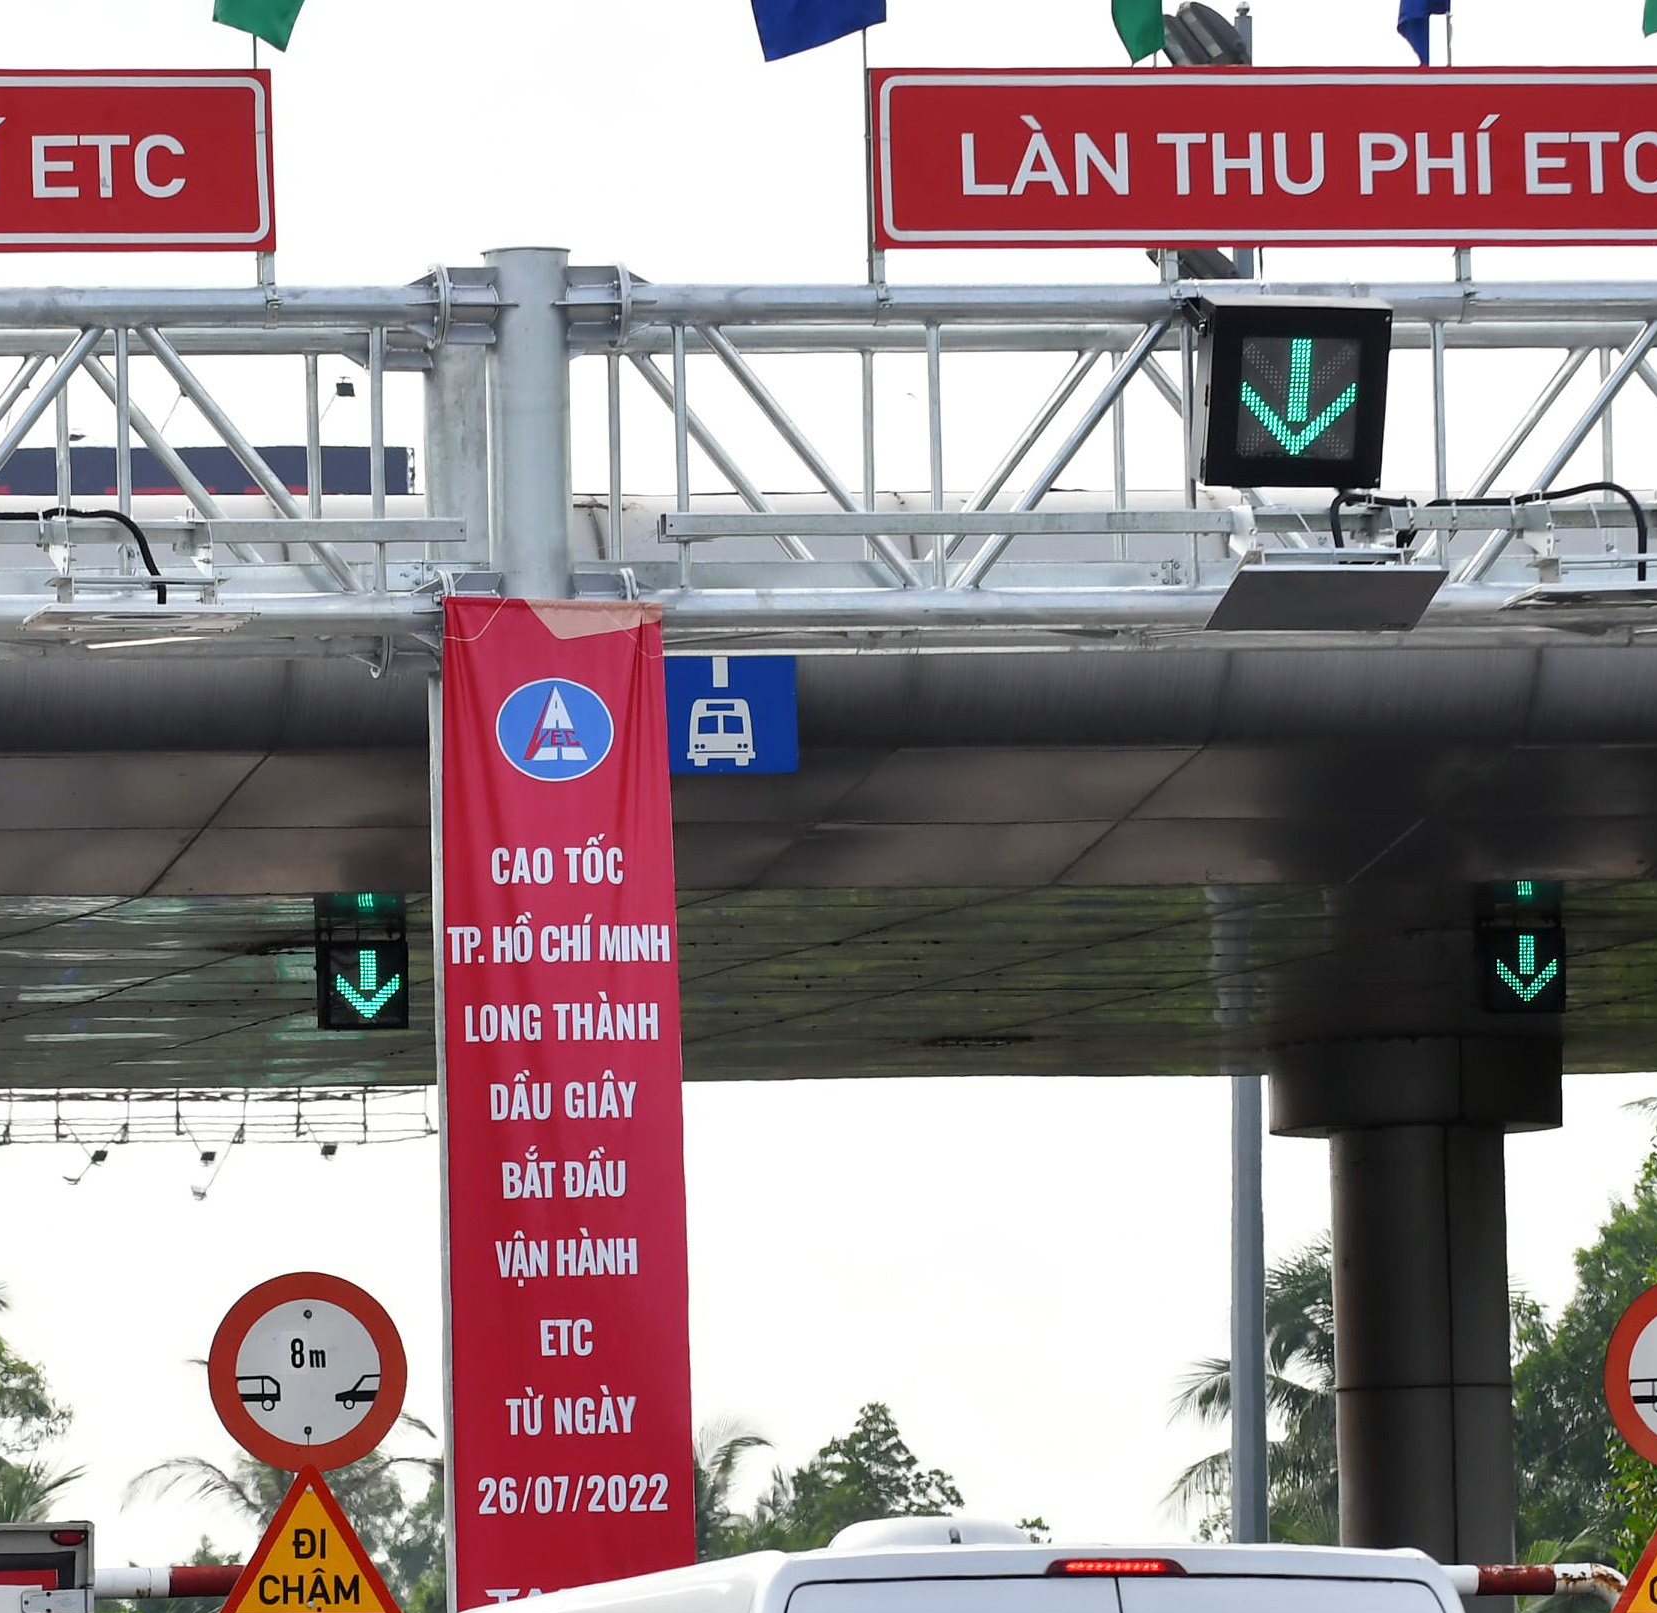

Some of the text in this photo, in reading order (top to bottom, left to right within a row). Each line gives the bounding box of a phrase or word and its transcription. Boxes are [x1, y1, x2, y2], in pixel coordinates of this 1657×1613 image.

[32, 134, 185, 198] ETC
[962, 115, 1129, 195] LÀN
[1157, 133, 1324, 195] THU
[1359, 114, 1491, 195] PHÍ
[492, 834, 623, 884] CAO TỐC
[447, 912, 670, 965] TP. HỒ CHÍ MINH
[465, 992, 658, 1042] LONG THÀNH
[491, 1070, 636, 1120] DẦU GIÂY
[502, 1146, 626, 1198] BẮT ĐẦU
[495, 1228, 637, 1286] VẬN HÀNH
[540, 1319, 592, 1356] ETC
[506, 1385, 636, 1435] TỪ NGÀY
[479, 1474, 668, 1514] 26/07/2022
[293, 1529, 326, 1559] ĐI
[259, 1568, 360, 1612] CHẬM
